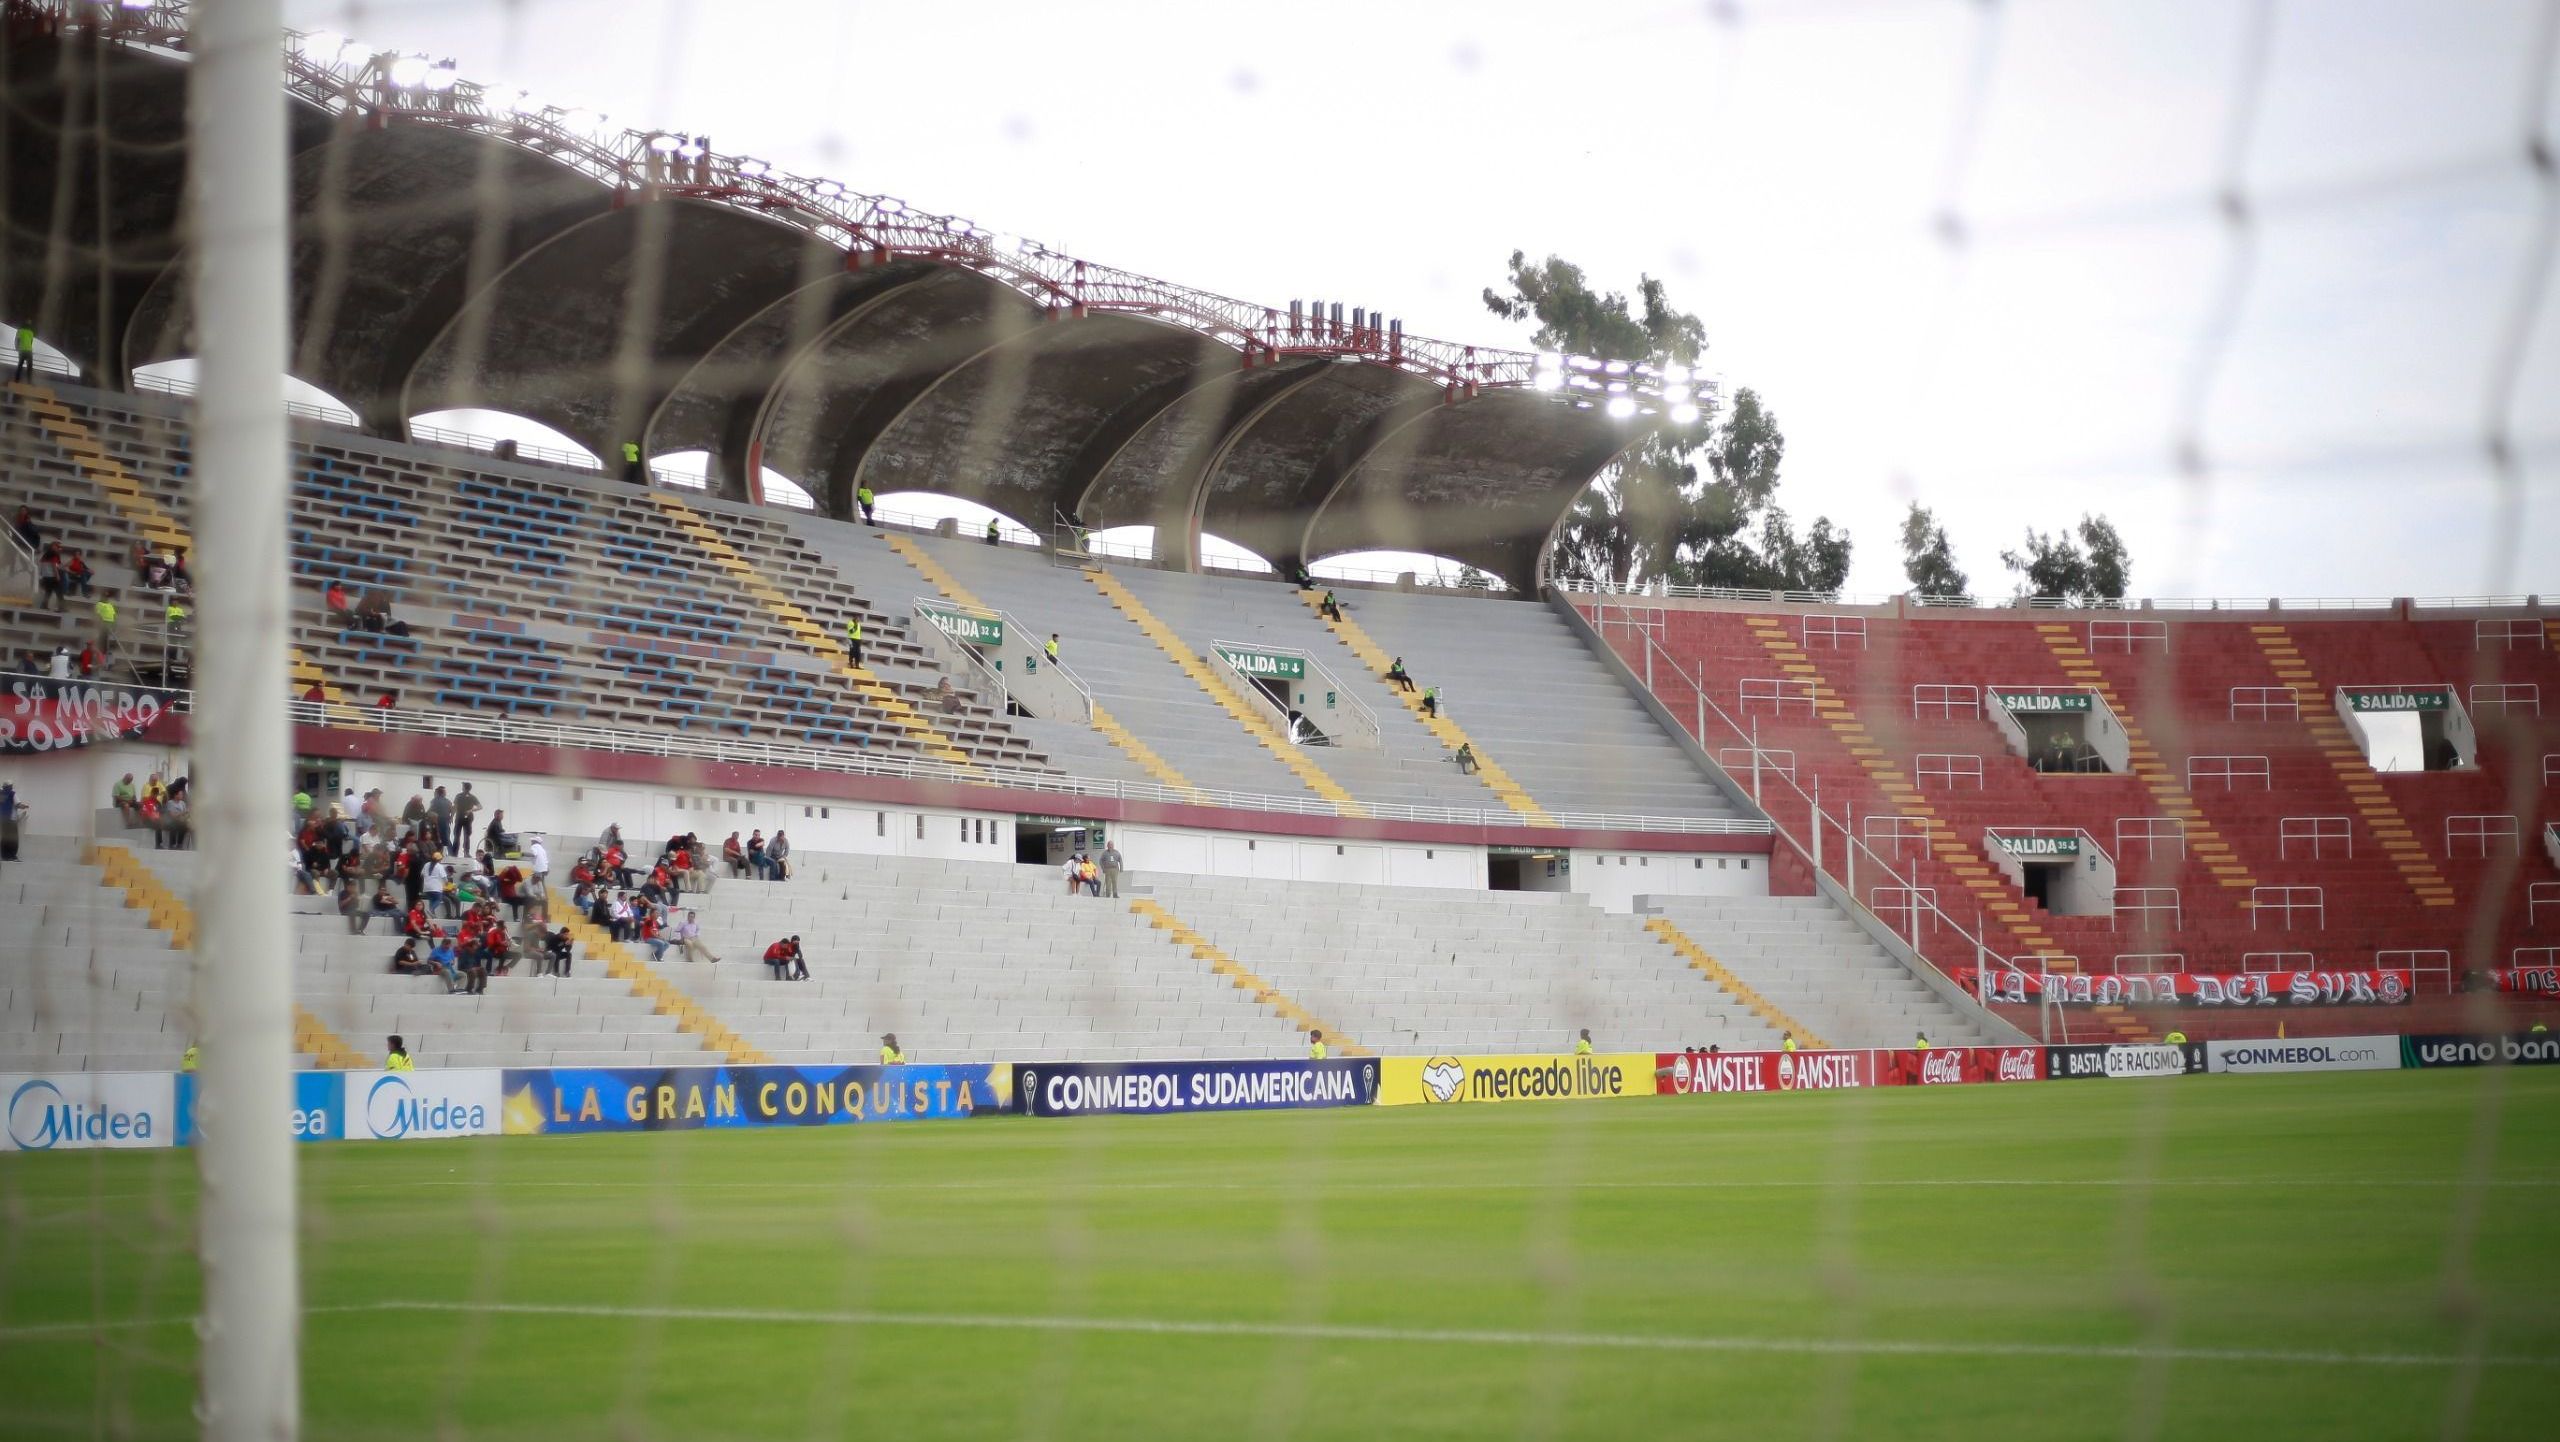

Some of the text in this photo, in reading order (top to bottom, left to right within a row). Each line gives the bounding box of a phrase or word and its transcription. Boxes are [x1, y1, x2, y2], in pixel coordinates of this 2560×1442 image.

[931, 614, 989, 638] SALIDA 32
[1228, 653, 1288, 673] SALIDA 33
[2006, 695, 2062, 710] SALIDA
[2360, 694, 2429, 709] SALIDA 37
[1040, 815, 1067, 824] SALIDA
[2002, 838, 2058, 854] SALIDA
[1984, 970, 2028, 1004] LA
[2044, 973, 2181, 1006] BANDA
[2191, 973, 2279, 1006] DEL
[2069, 1048, 2180, 1074] BASTA DE RACISMO
[2421, 1042, 2496, 1063] ueno
[1472, 1056, 1623, 1099] mercado libre
[1692, 1056, 1765, 1093] AMSTEL
[1796, 1054, 1860, 1089] AMSTEL
[553, 1080, 976, 1122] LA GRAN CONQUISTA
[1046, 1069, 1356, 1111] CONMEBOL SUDAMERICANA
[31, 1103, 152, 1142] Midea
[384, 1096, 486, 1132] Midea
